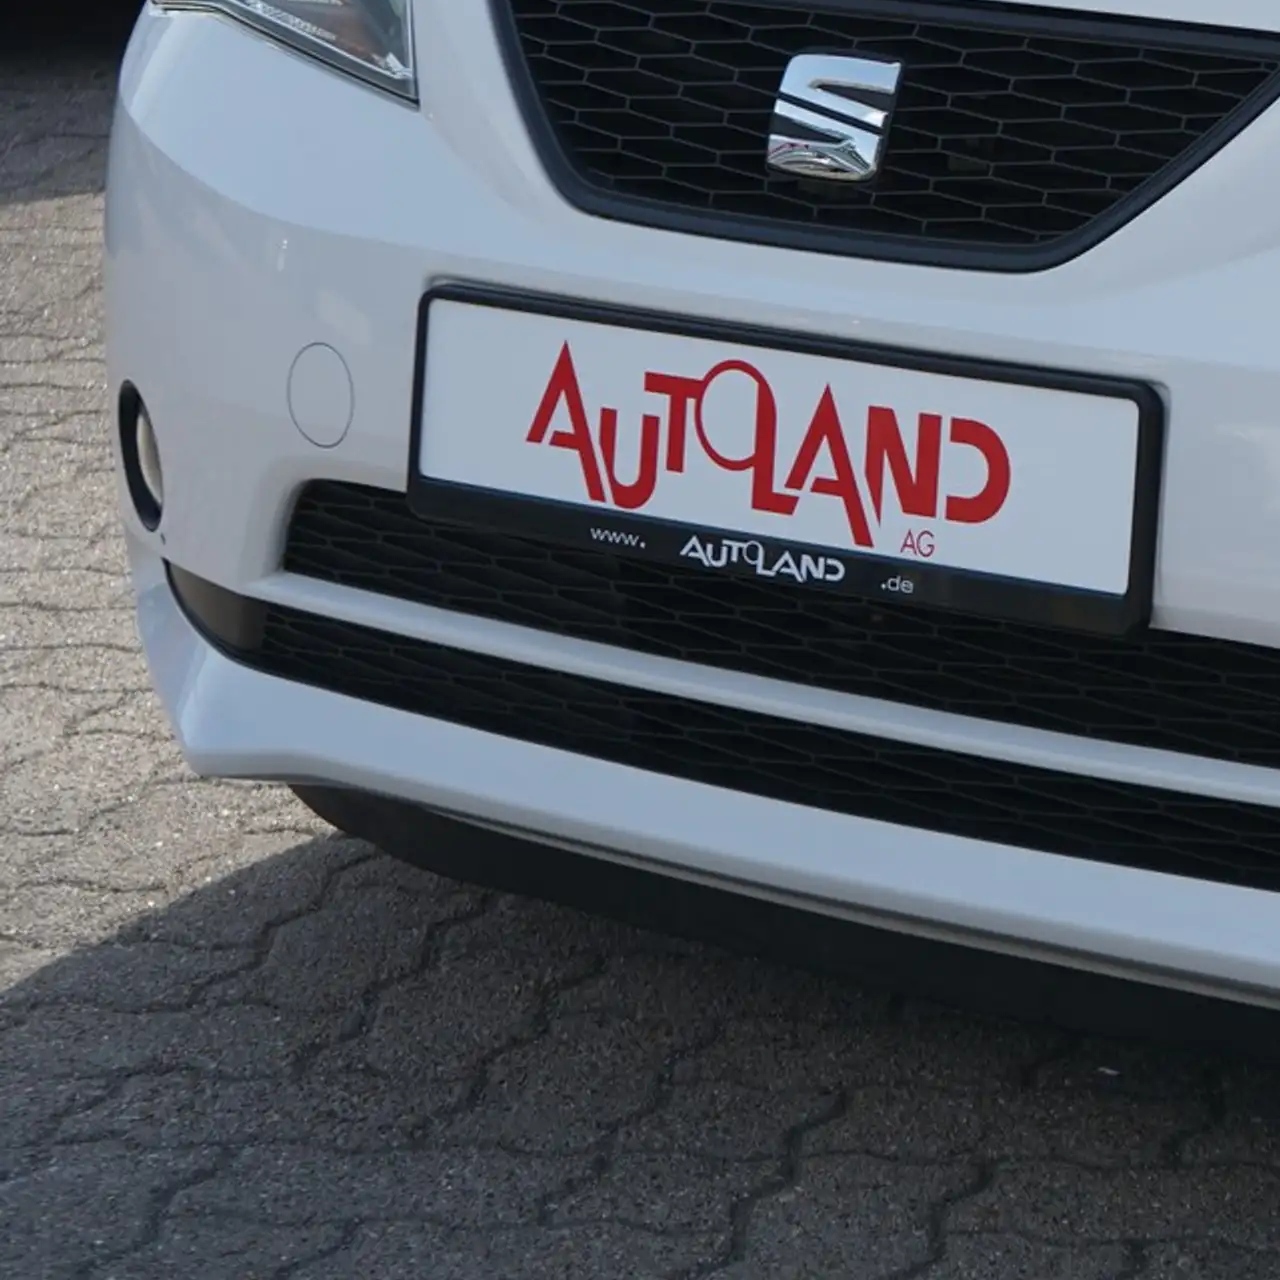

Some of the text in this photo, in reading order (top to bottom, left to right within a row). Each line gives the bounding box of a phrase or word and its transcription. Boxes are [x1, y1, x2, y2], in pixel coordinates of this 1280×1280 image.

[526, 339, 1011, 549] AUTOLAND
[590, 527, 647, 549] www.
[680, 535, 846, 584] AUTOLAND
[900, 528, 935, 558] AG
